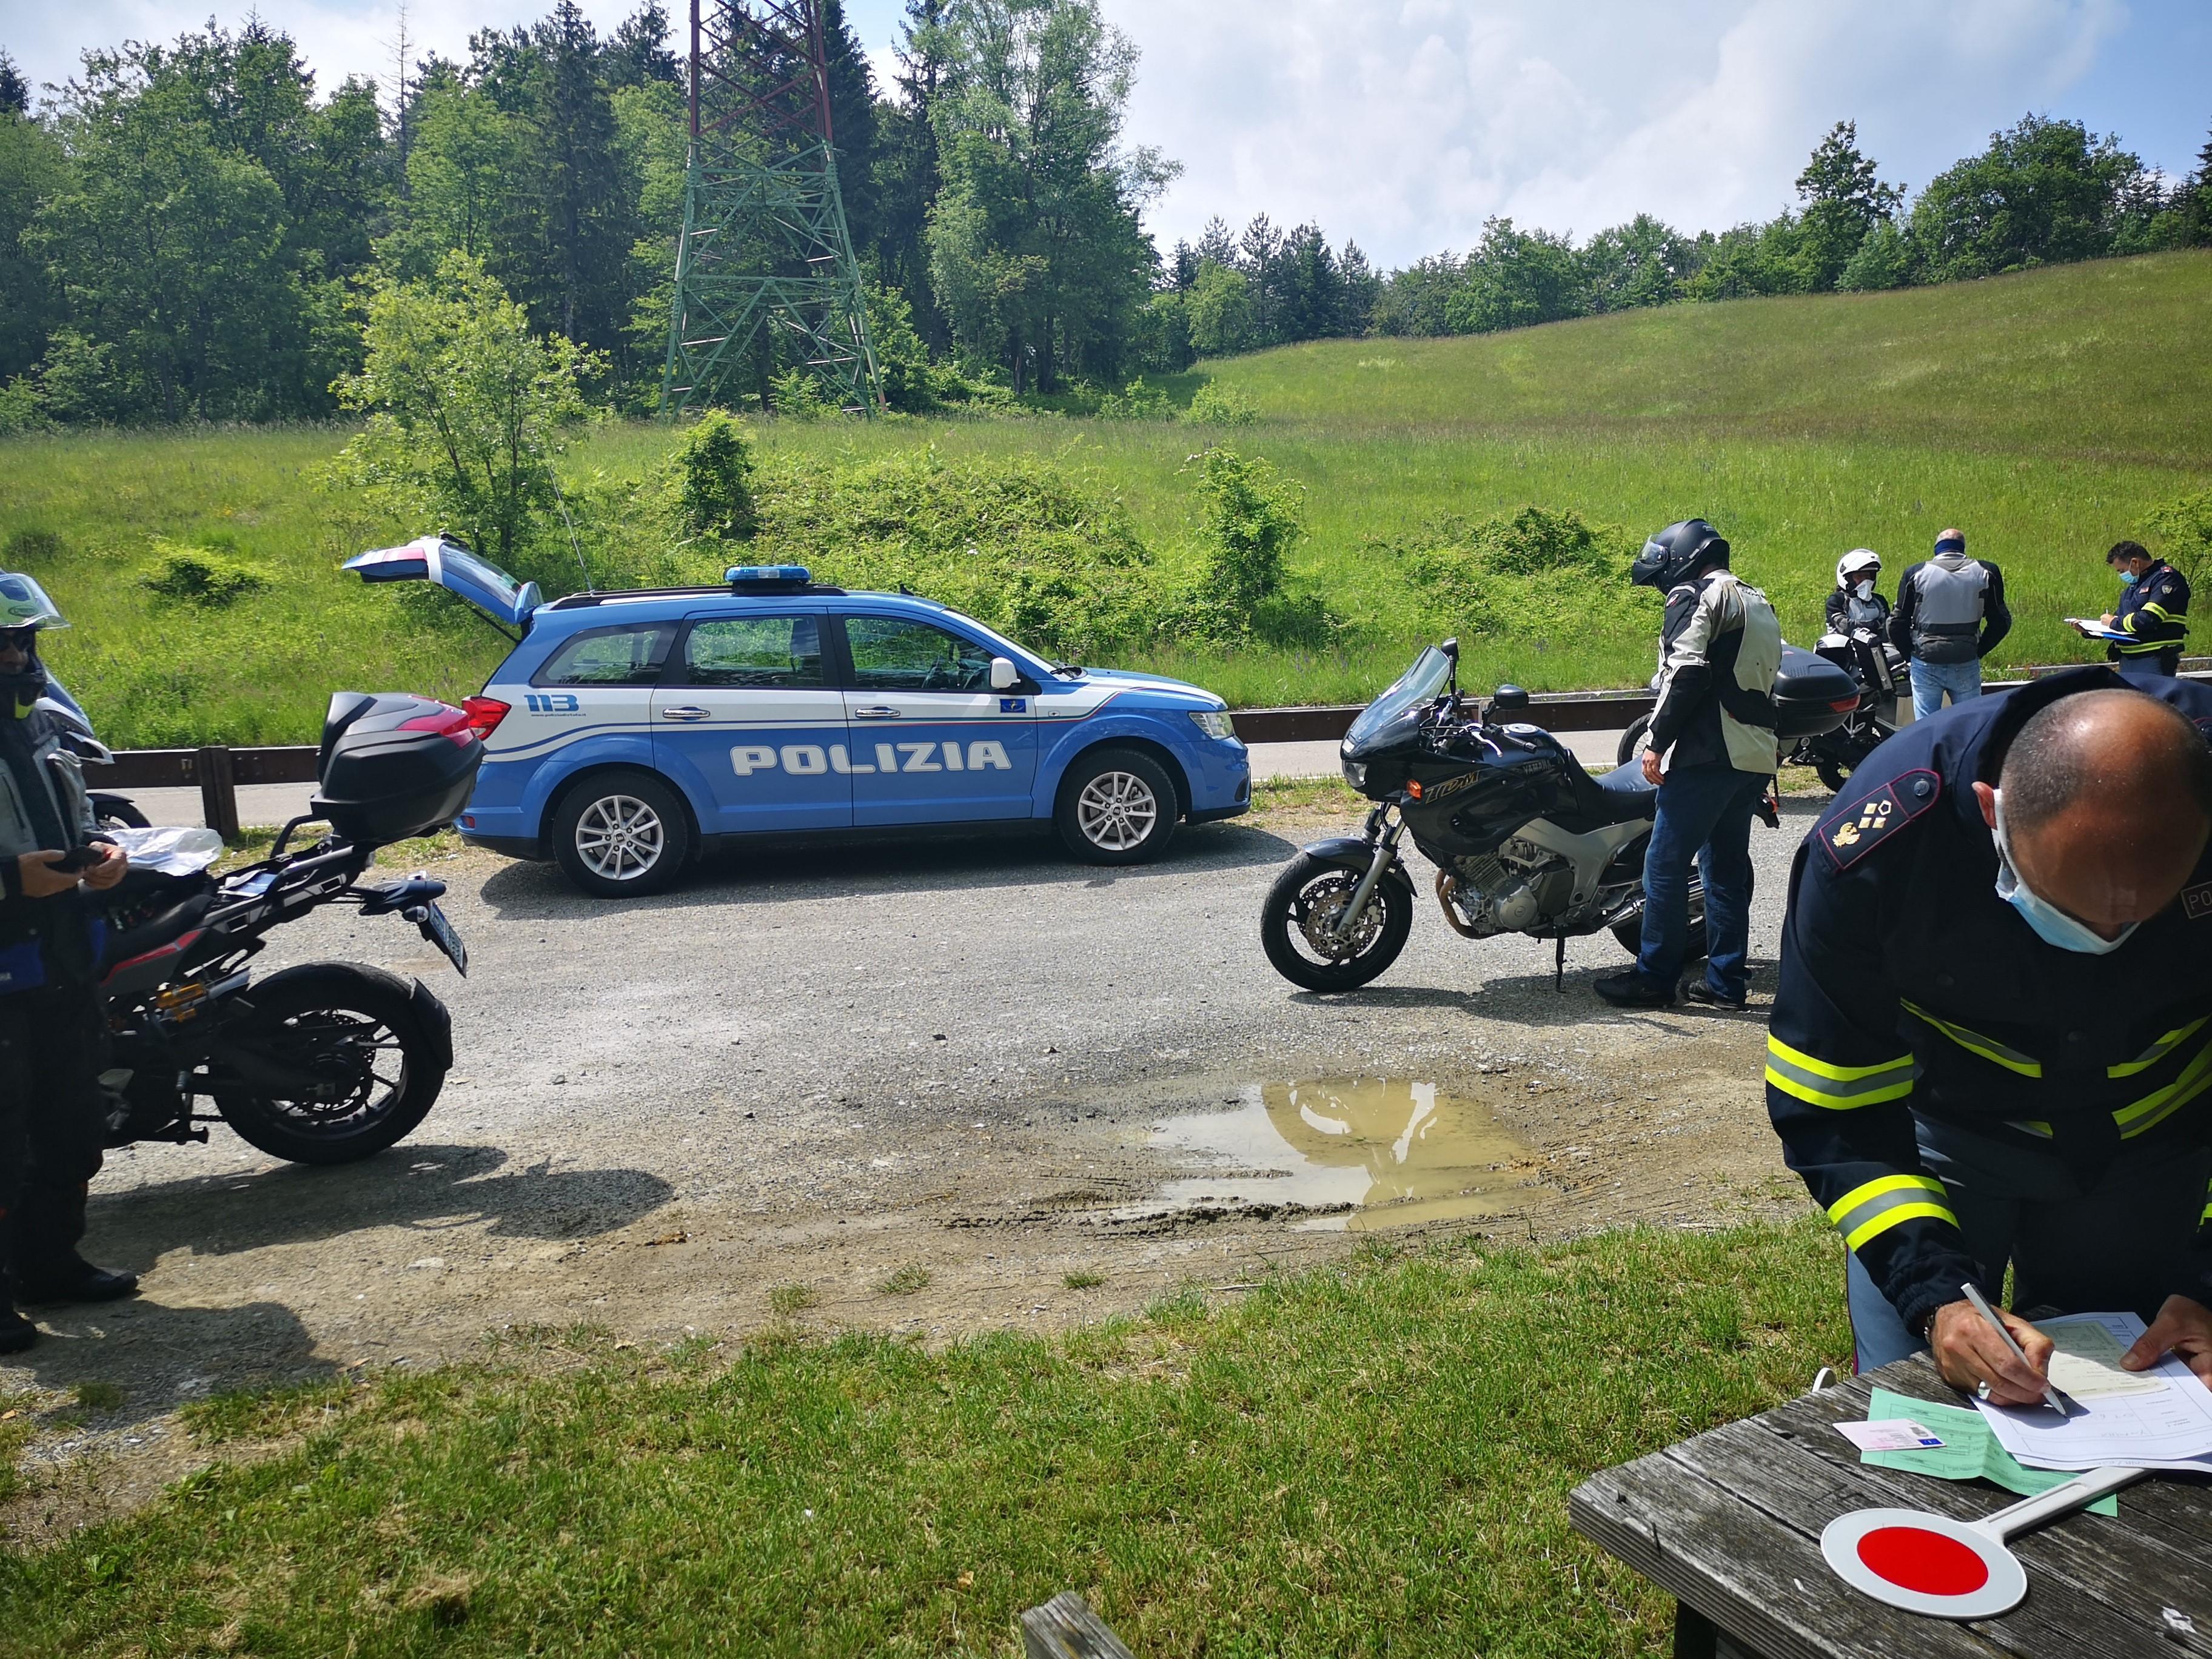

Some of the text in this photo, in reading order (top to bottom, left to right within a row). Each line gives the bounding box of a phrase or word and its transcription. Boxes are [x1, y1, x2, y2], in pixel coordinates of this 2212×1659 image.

[524, 694, 580, 712] 113
[729, 740, 1012, 776] POLIZIA
[1523, 759, 1553, 775] YAMAHA
[1424, 770, 1480, 805] TDM
